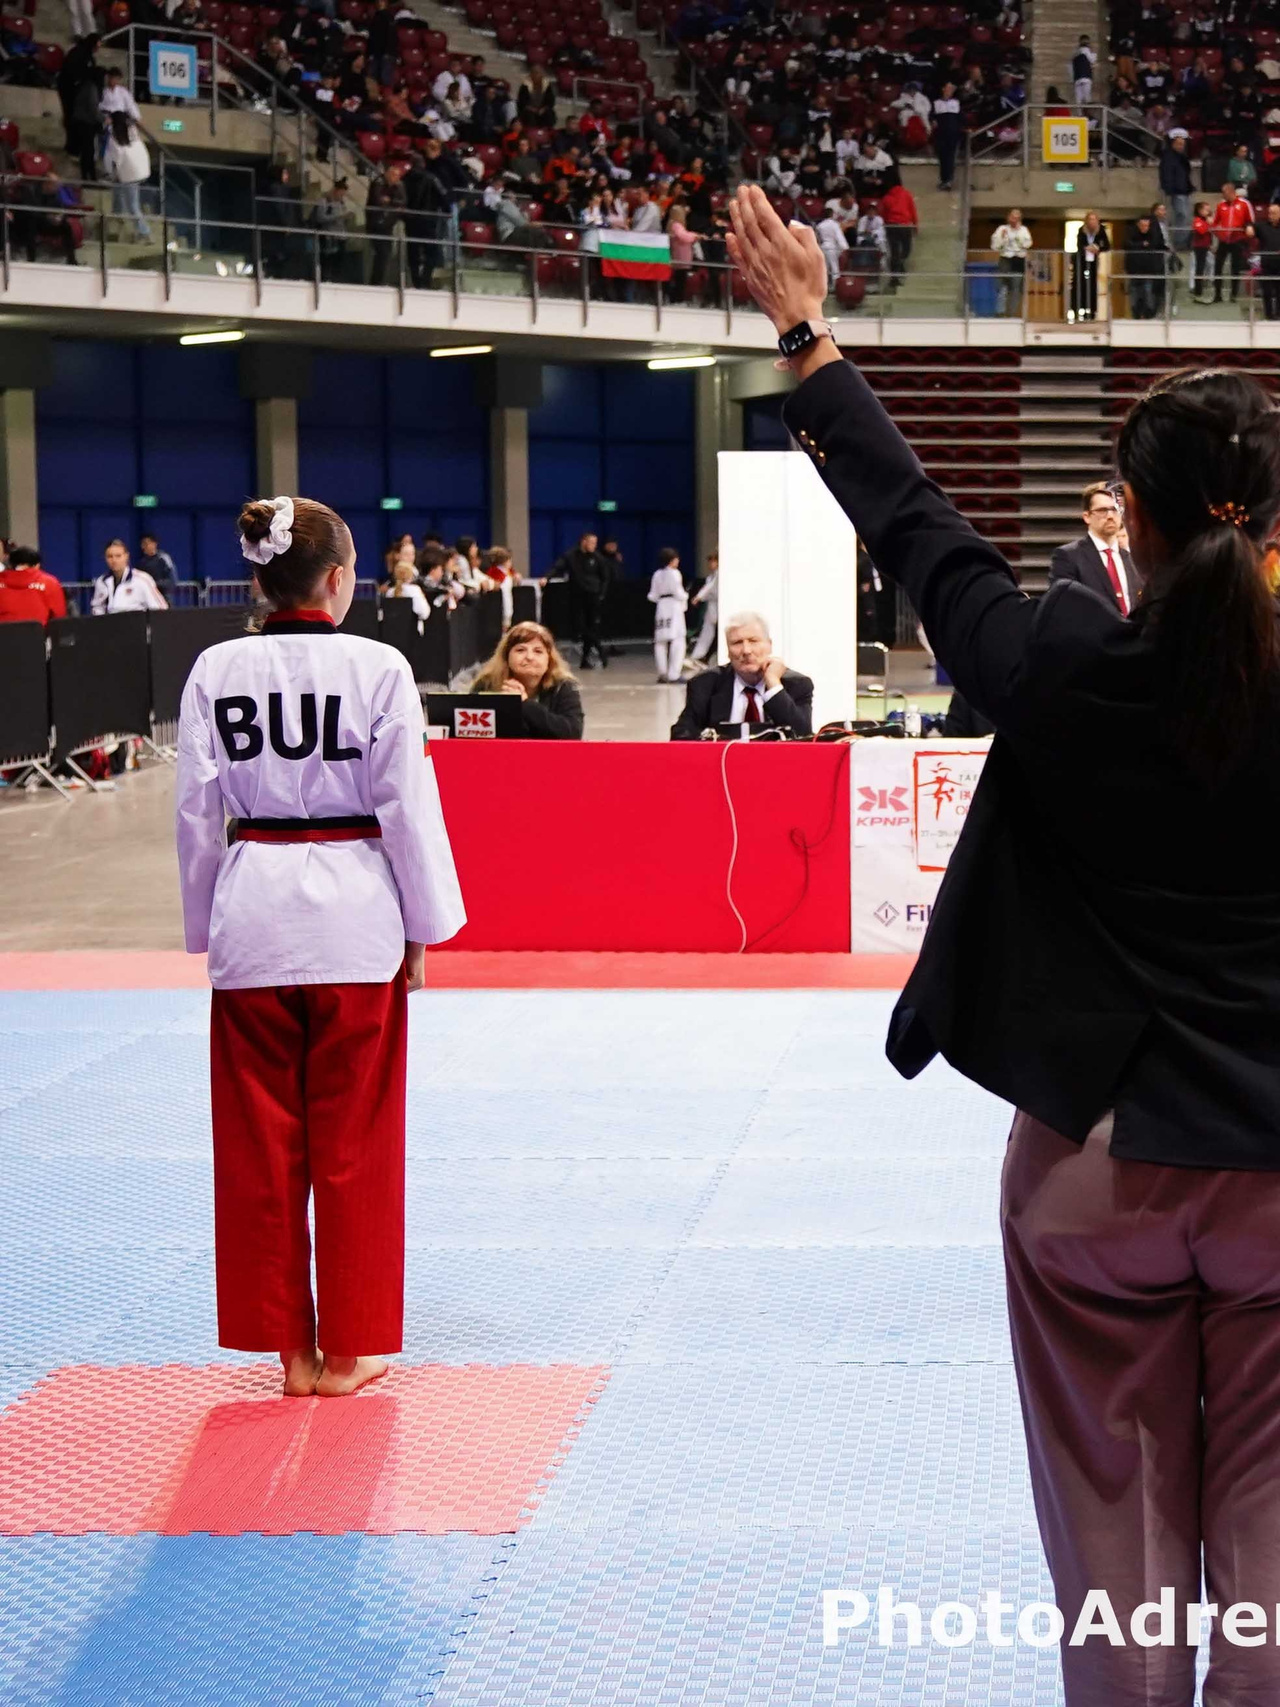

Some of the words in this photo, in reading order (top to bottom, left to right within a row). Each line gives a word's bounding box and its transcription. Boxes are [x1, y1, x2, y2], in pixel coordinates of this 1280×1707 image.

[161, 61, 186, 79] 106
[1053, 133, 1078, 147] 105
[214, 692, 363, 762] BUL
[856, 817, 910, 827] KPNP
